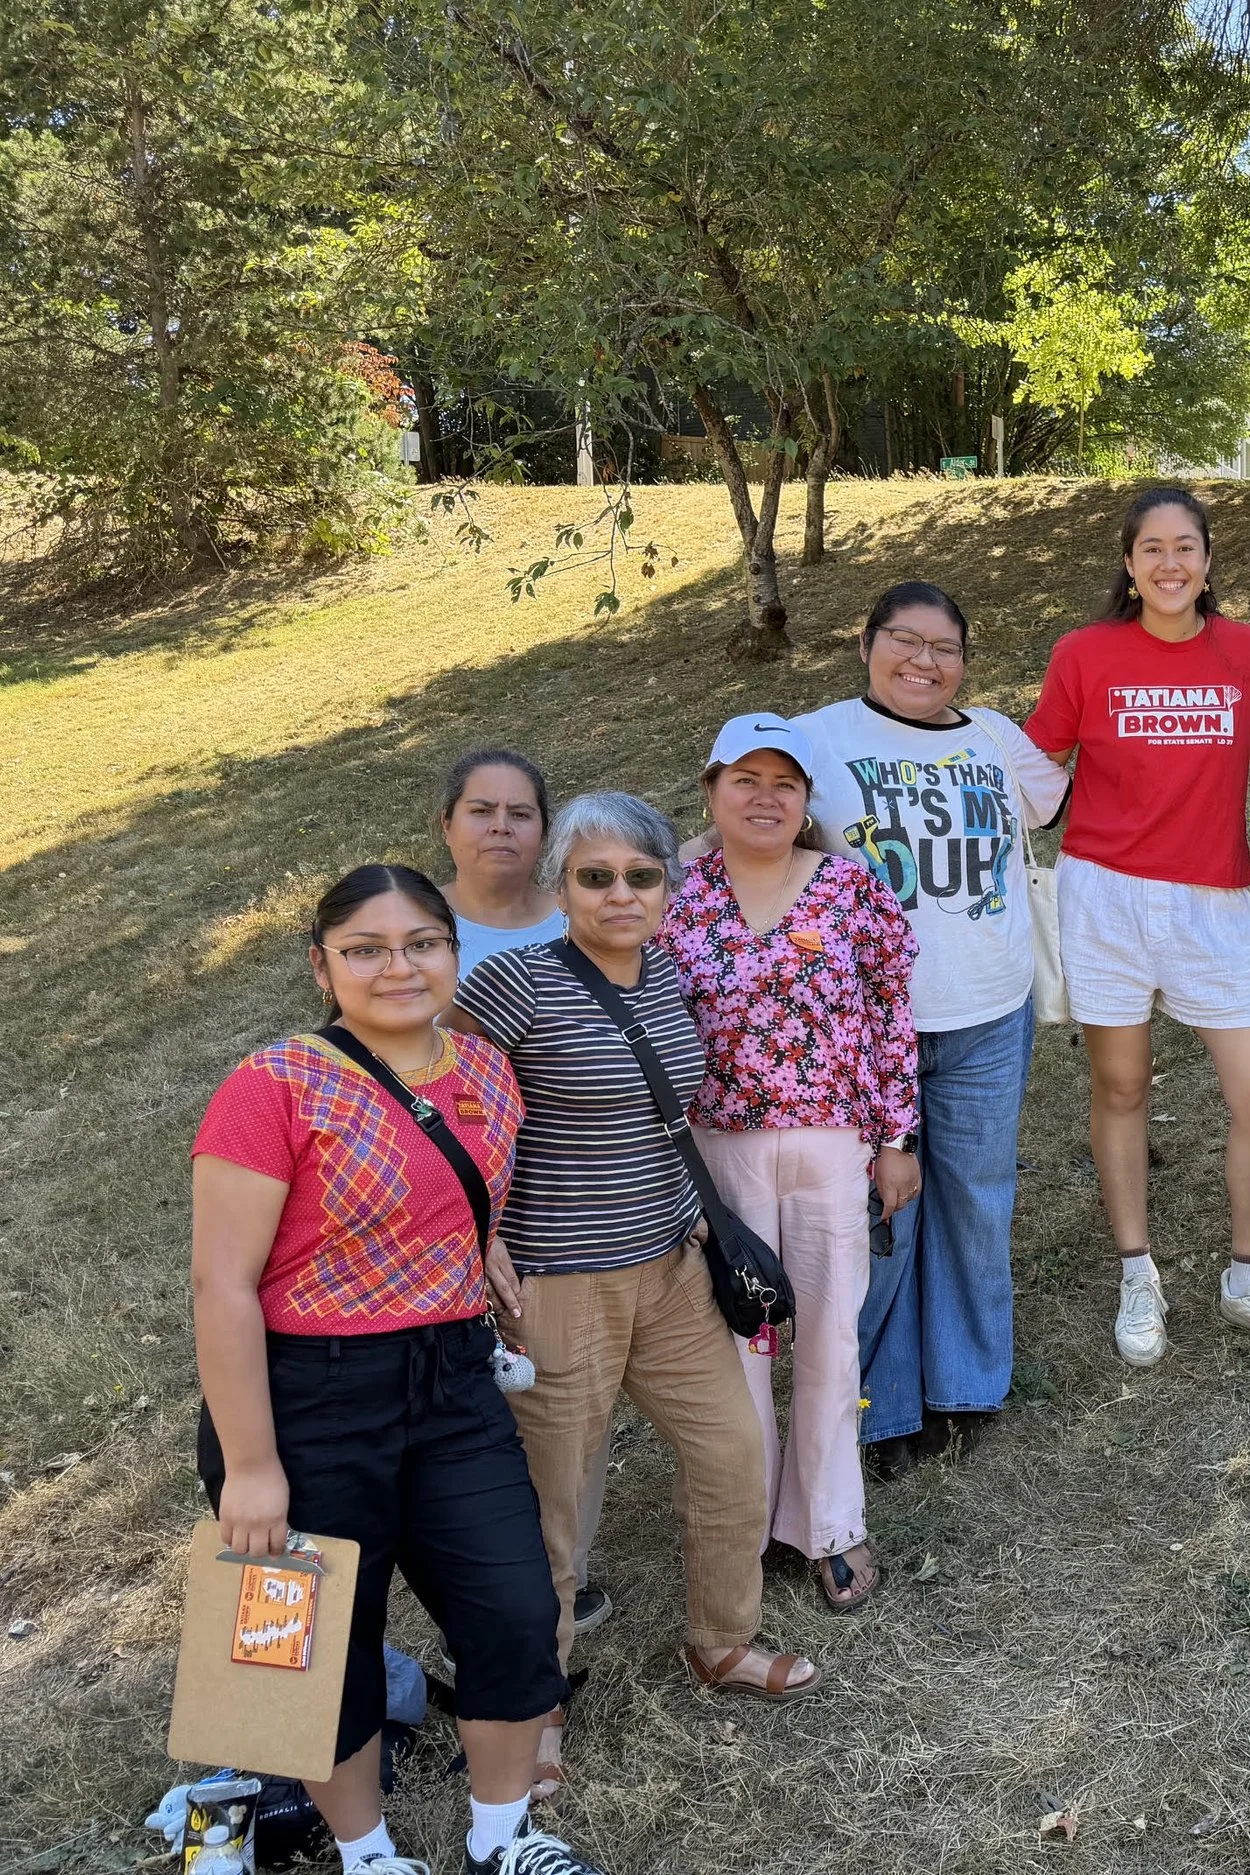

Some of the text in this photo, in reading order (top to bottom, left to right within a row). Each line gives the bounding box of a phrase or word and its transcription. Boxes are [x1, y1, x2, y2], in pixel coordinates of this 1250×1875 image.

[1121, 688, 1220, 708] TATIANA
[1124, 713, 1228, 734] BROWN.
[846, 757, 941, 789] WHO'S
